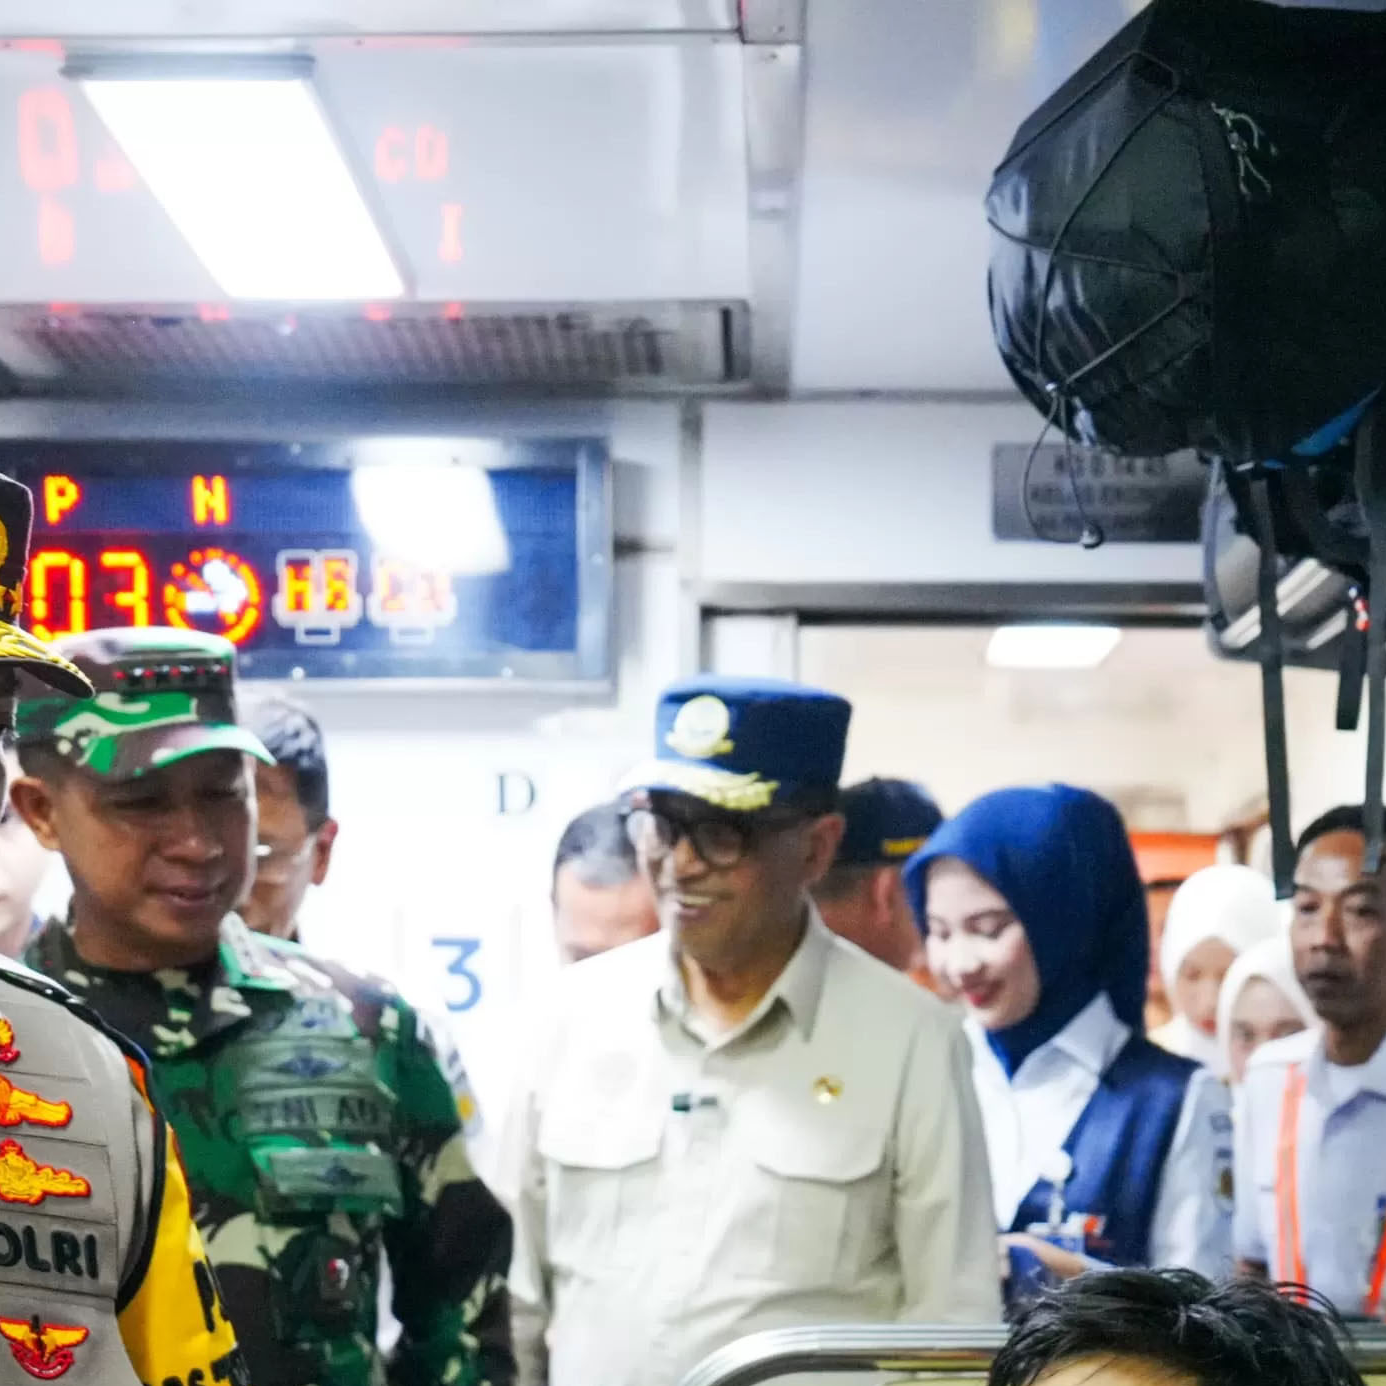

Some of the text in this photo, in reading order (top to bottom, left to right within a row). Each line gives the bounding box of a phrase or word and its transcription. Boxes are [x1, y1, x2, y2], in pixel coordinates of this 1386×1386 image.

[44, 475, 229, 525] P N
[495, 772, 537, 815] D
[431, 937, 482, 1013] 3
